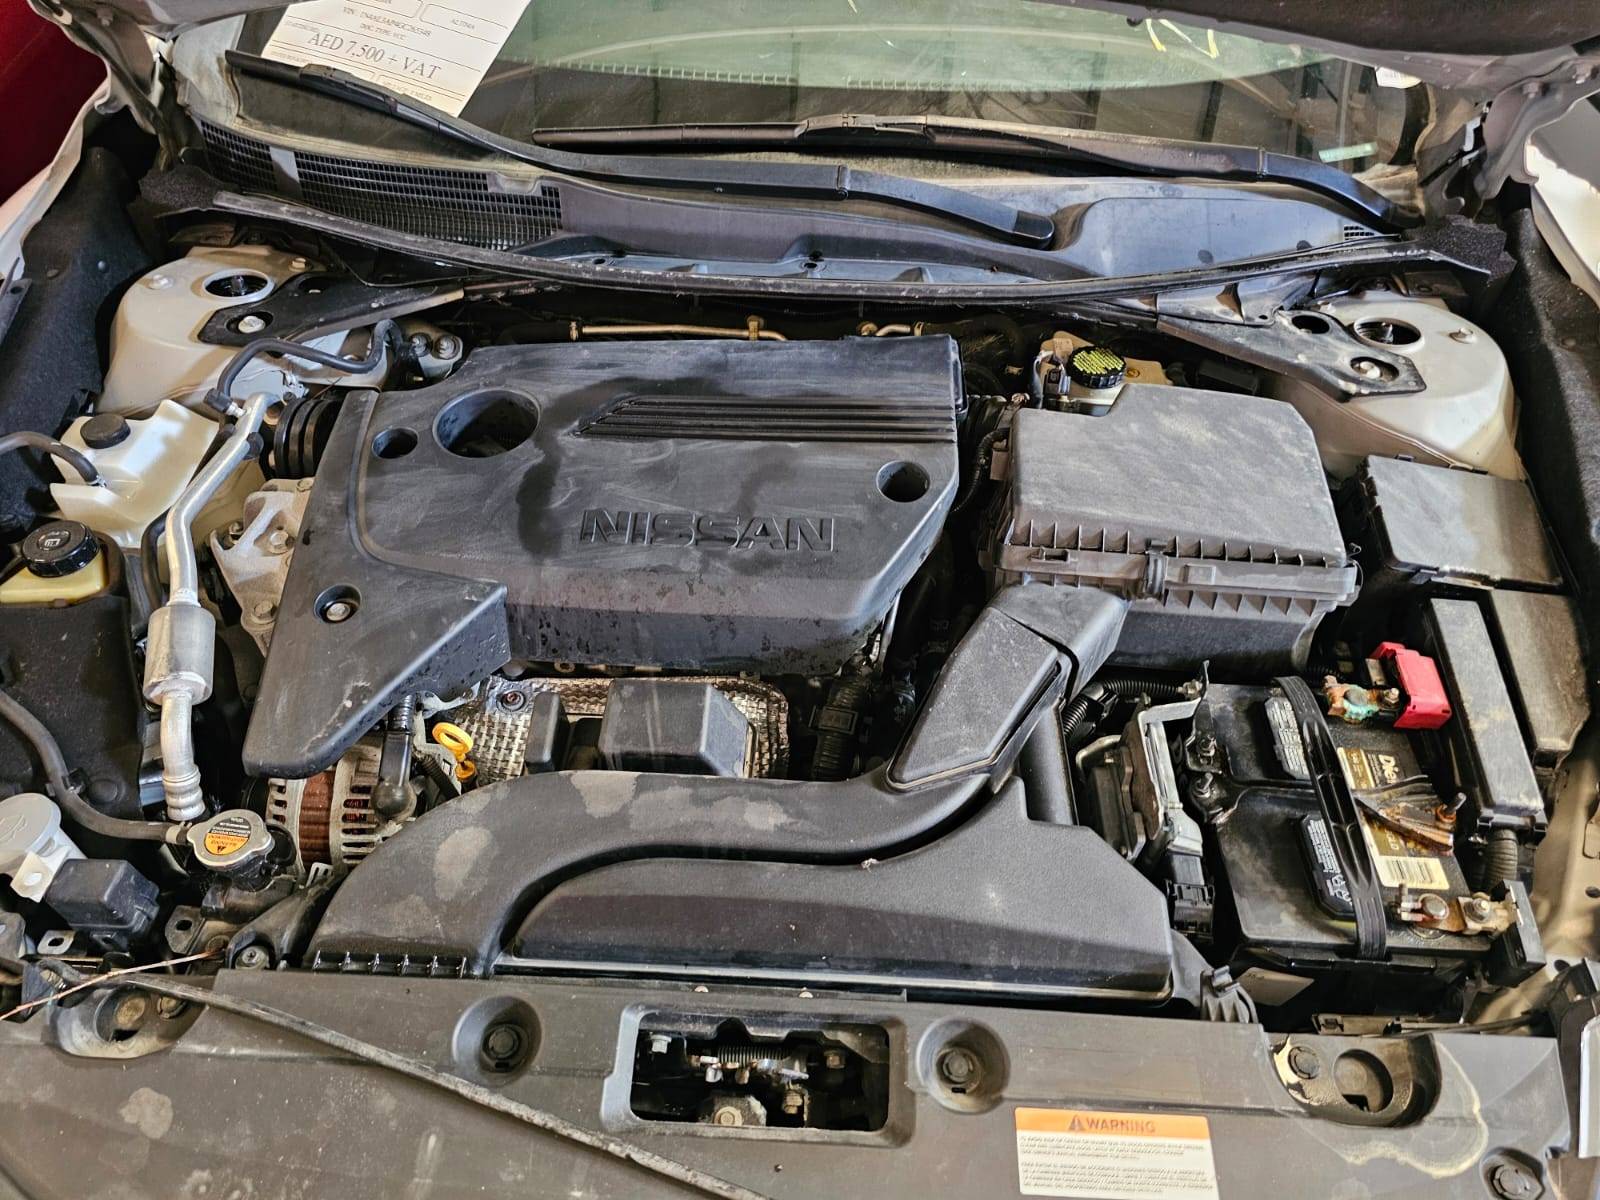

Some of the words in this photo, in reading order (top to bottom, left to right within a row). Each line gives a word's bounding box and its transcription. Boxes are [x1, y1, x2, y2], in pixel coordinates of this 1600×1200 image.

[308, 32, 344, 51] AED
[388, 53, 399, 65] +
[403, 57, 441, 80] VAT
[580, 509, 837, 552] NISSAN
[1086, 1117, 1156, 1133] WARNING
